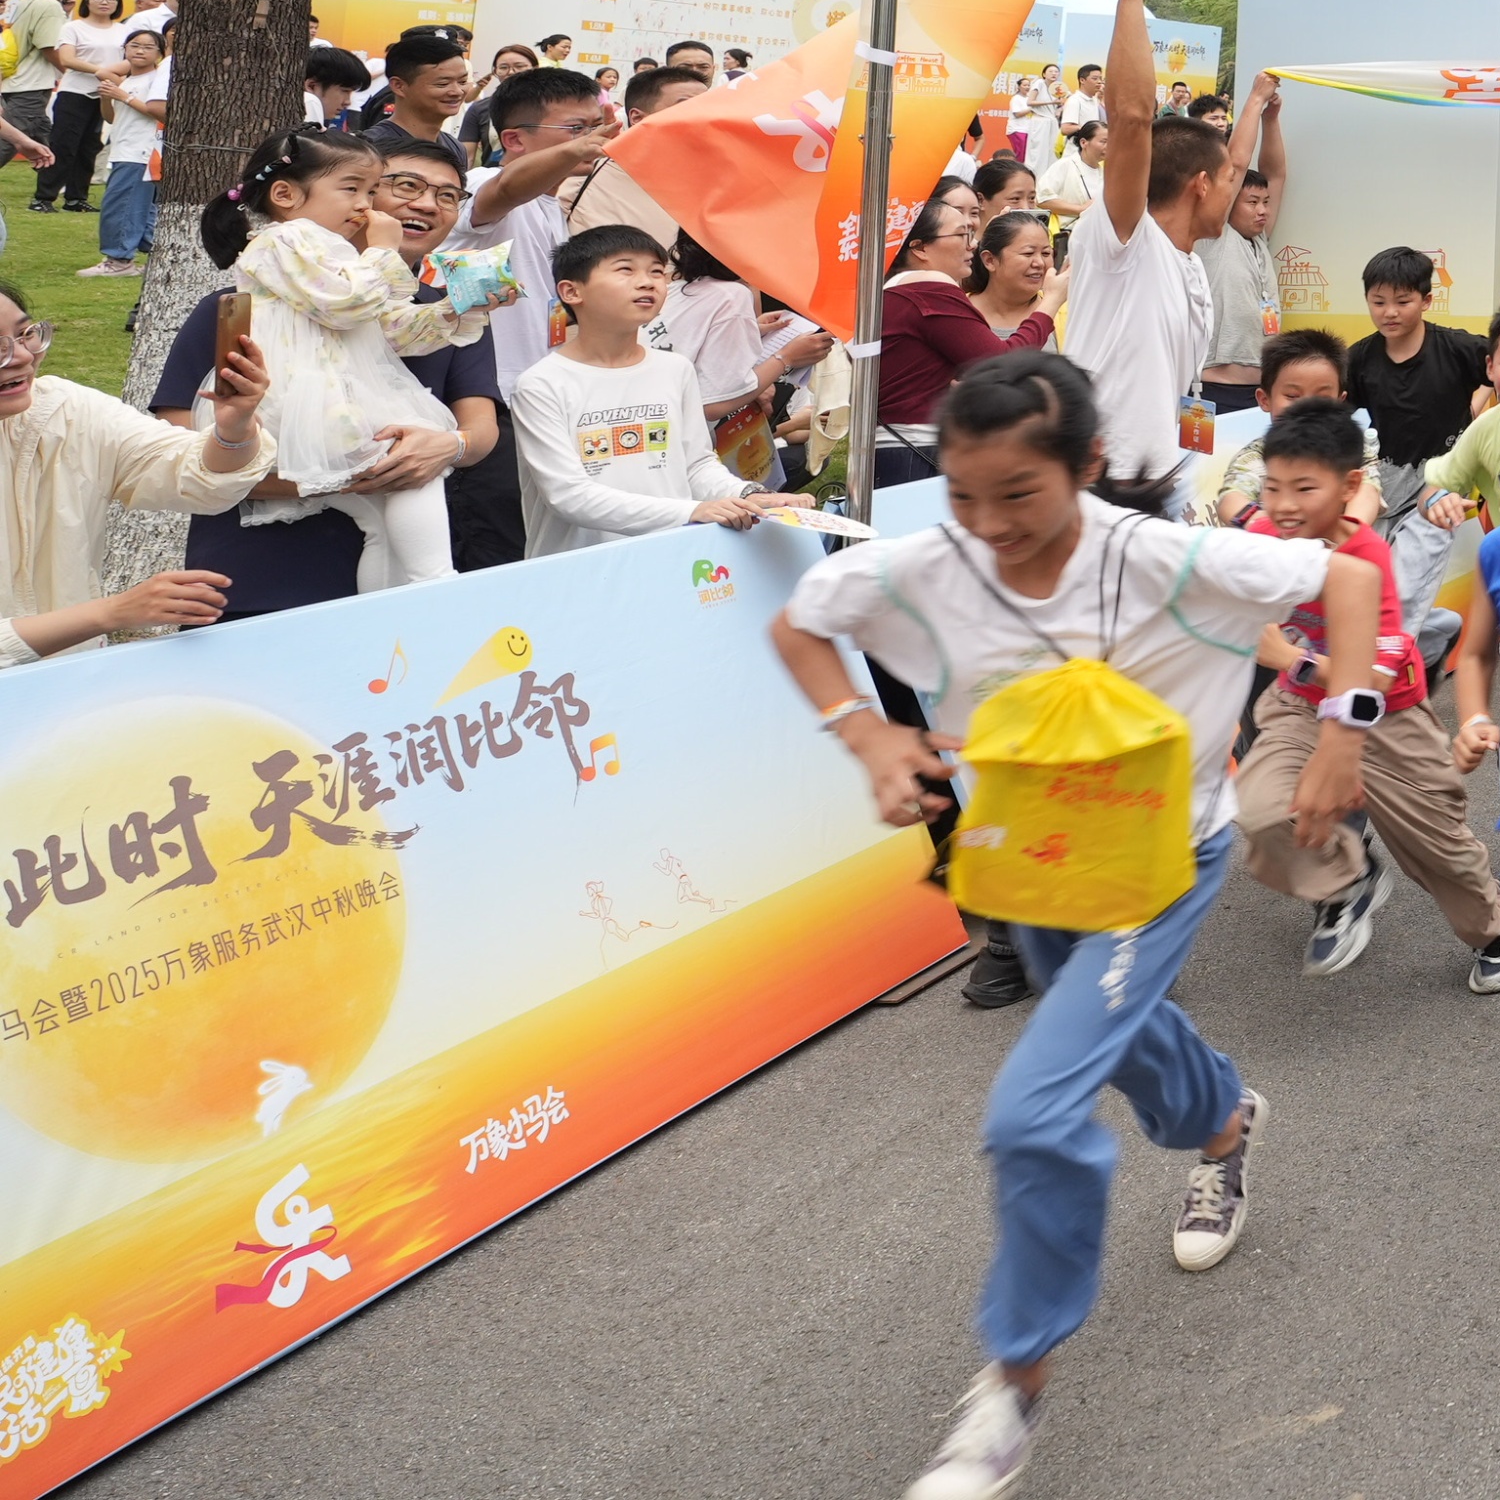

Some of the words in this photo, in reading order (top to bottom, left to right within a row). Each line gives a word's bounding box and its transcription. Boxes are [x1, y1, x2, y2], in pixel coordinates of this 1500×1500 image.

[584, 53, 602, 63] 1.4M
[588, 21, 606, 31] 1.8M
[577, 403, 667, 428] ADVENTURES
[227, 671, 592, 866] 天涯润比邻
[94, 923, 144, 949] LAND
[157, 906, 192, 925] FOR
[202, 880, 265, 910] BETTER
[275, 864, 312, 882] CITY
[0, 870, 401, 1042] 马会暨2025万象服务武汉中秋晚会
[459, 1085, 570, 1175] 万象小马会
